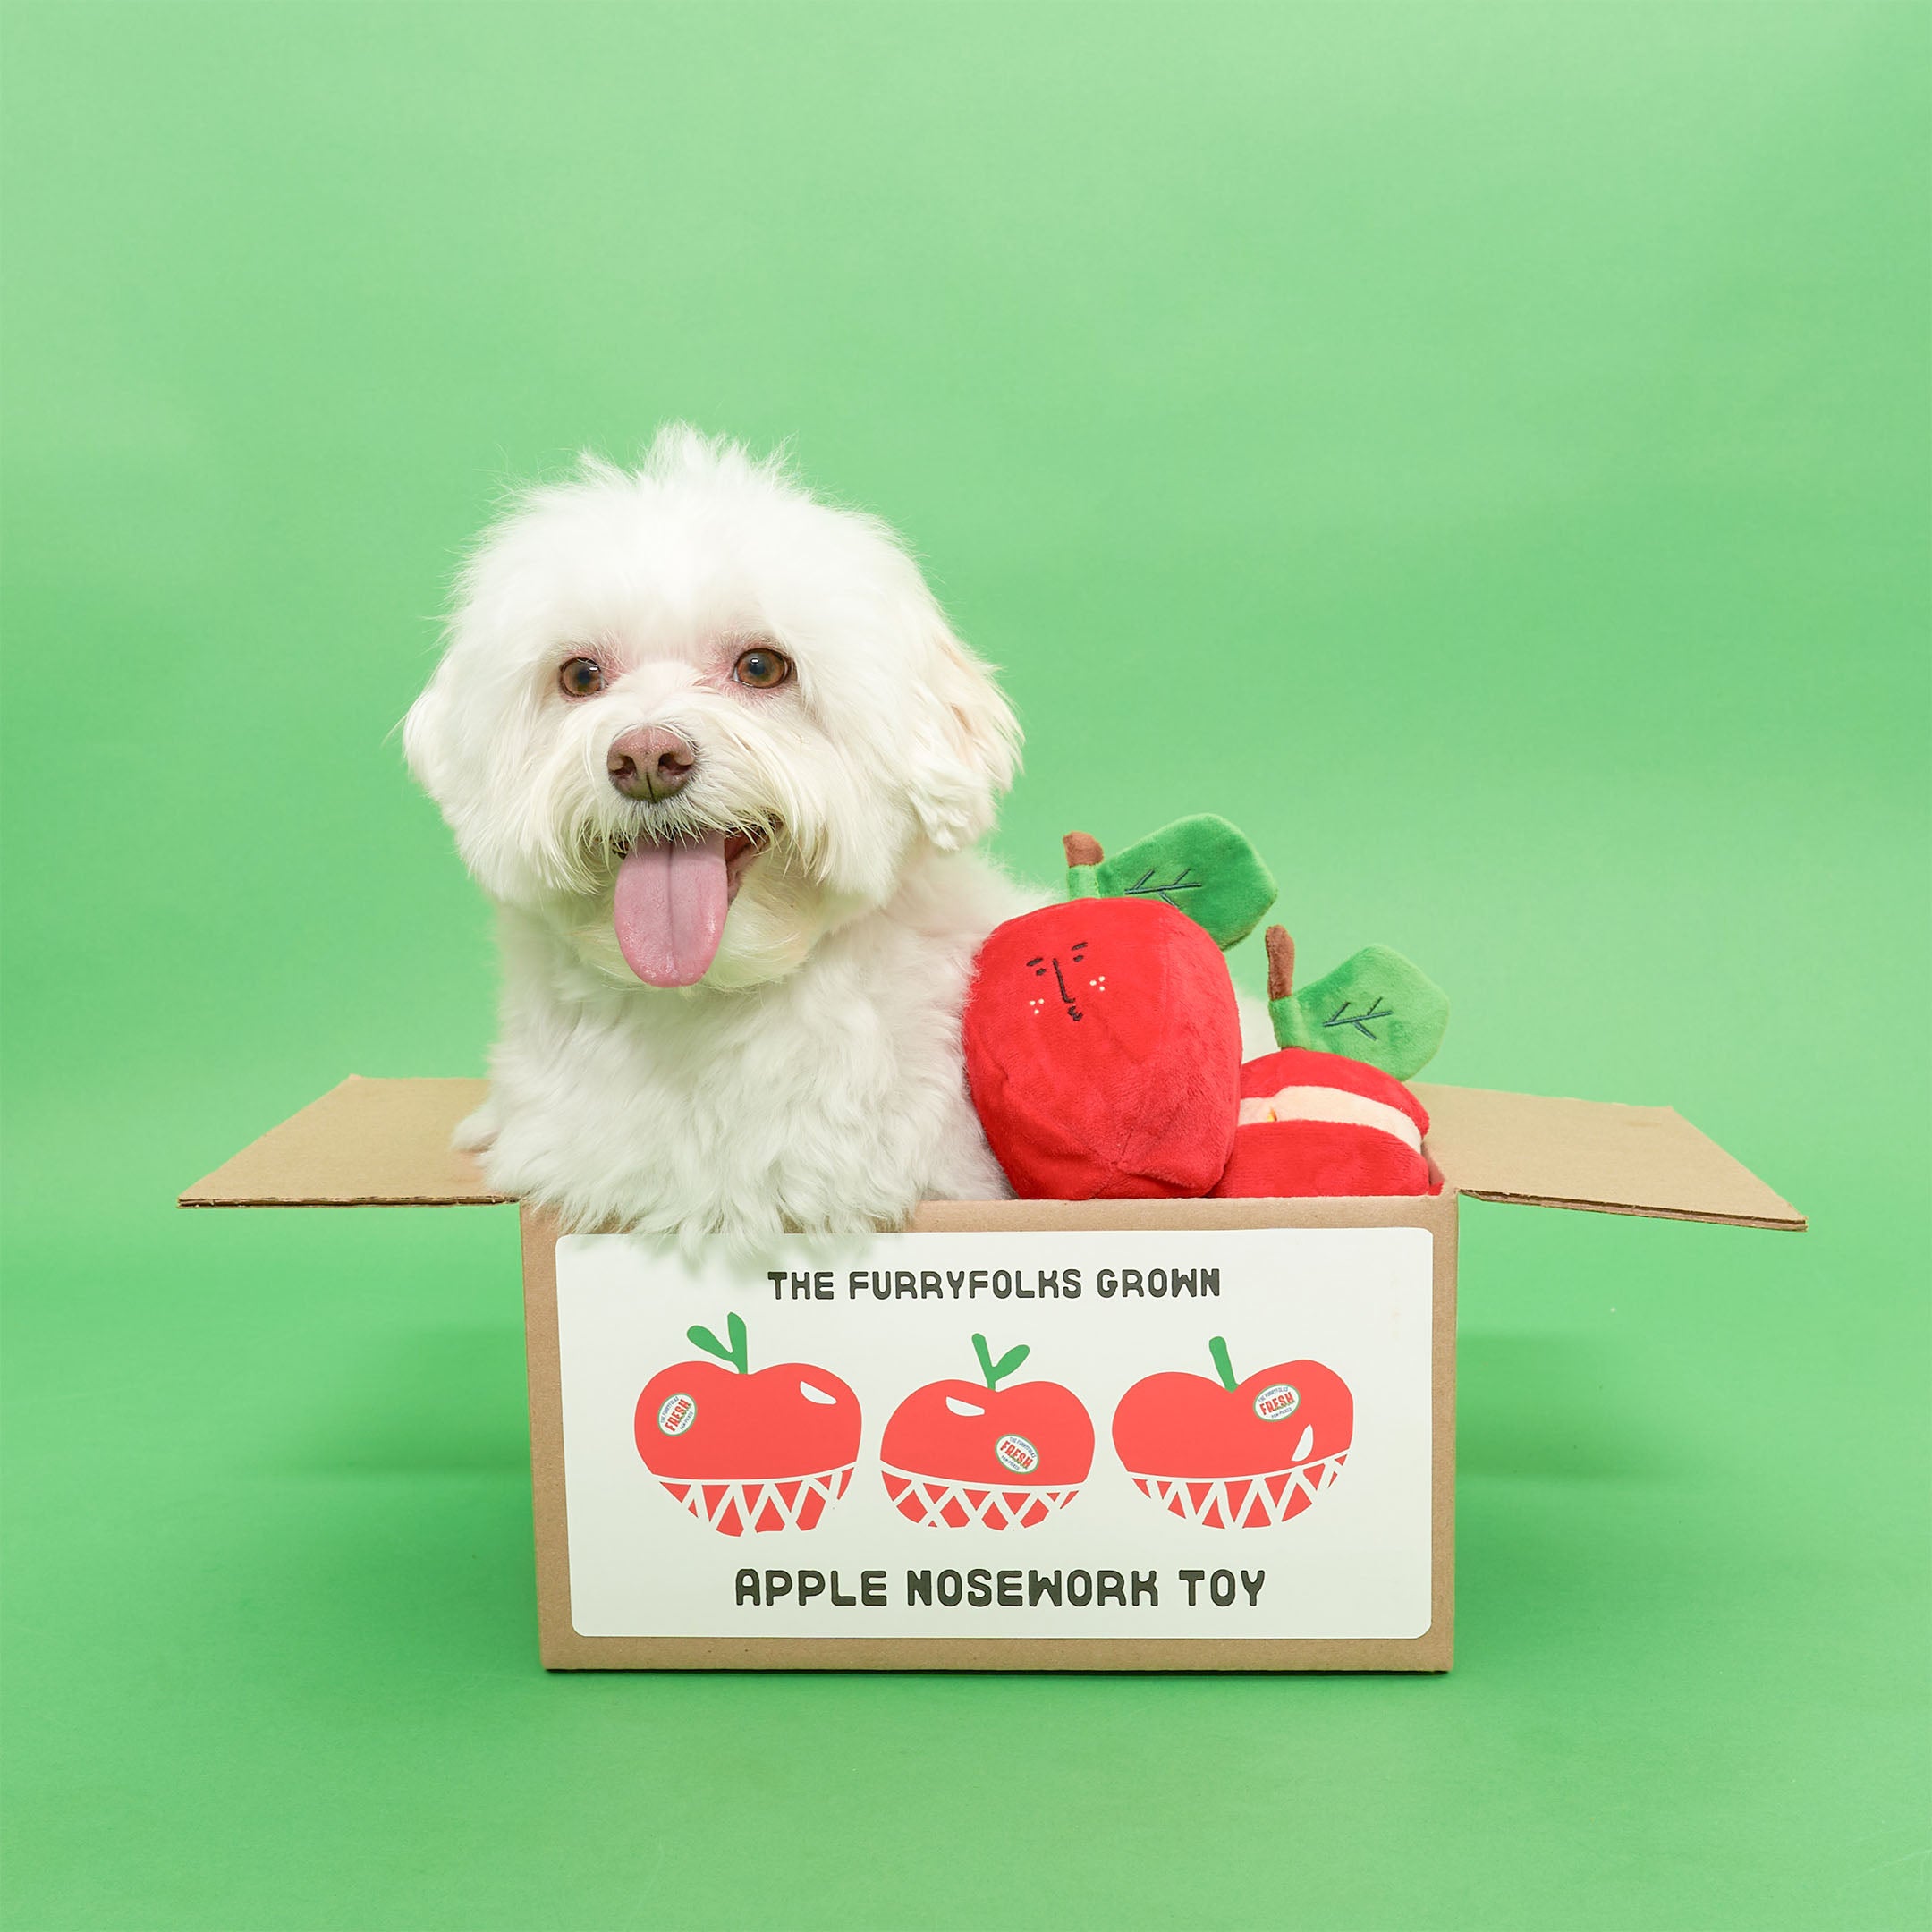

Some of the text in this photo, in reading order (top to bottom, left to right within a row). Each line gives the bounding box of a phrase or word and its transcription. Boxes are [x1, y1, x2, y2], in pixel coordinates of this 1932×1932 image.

[767, 1268, 1219, 1300] THE FURRYFOLKS GROWN
[665, 1398, 691, 1432] FRESH
[1259, 1392, 1294, 1416] FRESH
[1000, 1440, 1033, 1469] FRESH
[736, 1569, 1265, 1607] APPLE NOSEWORK TOY
